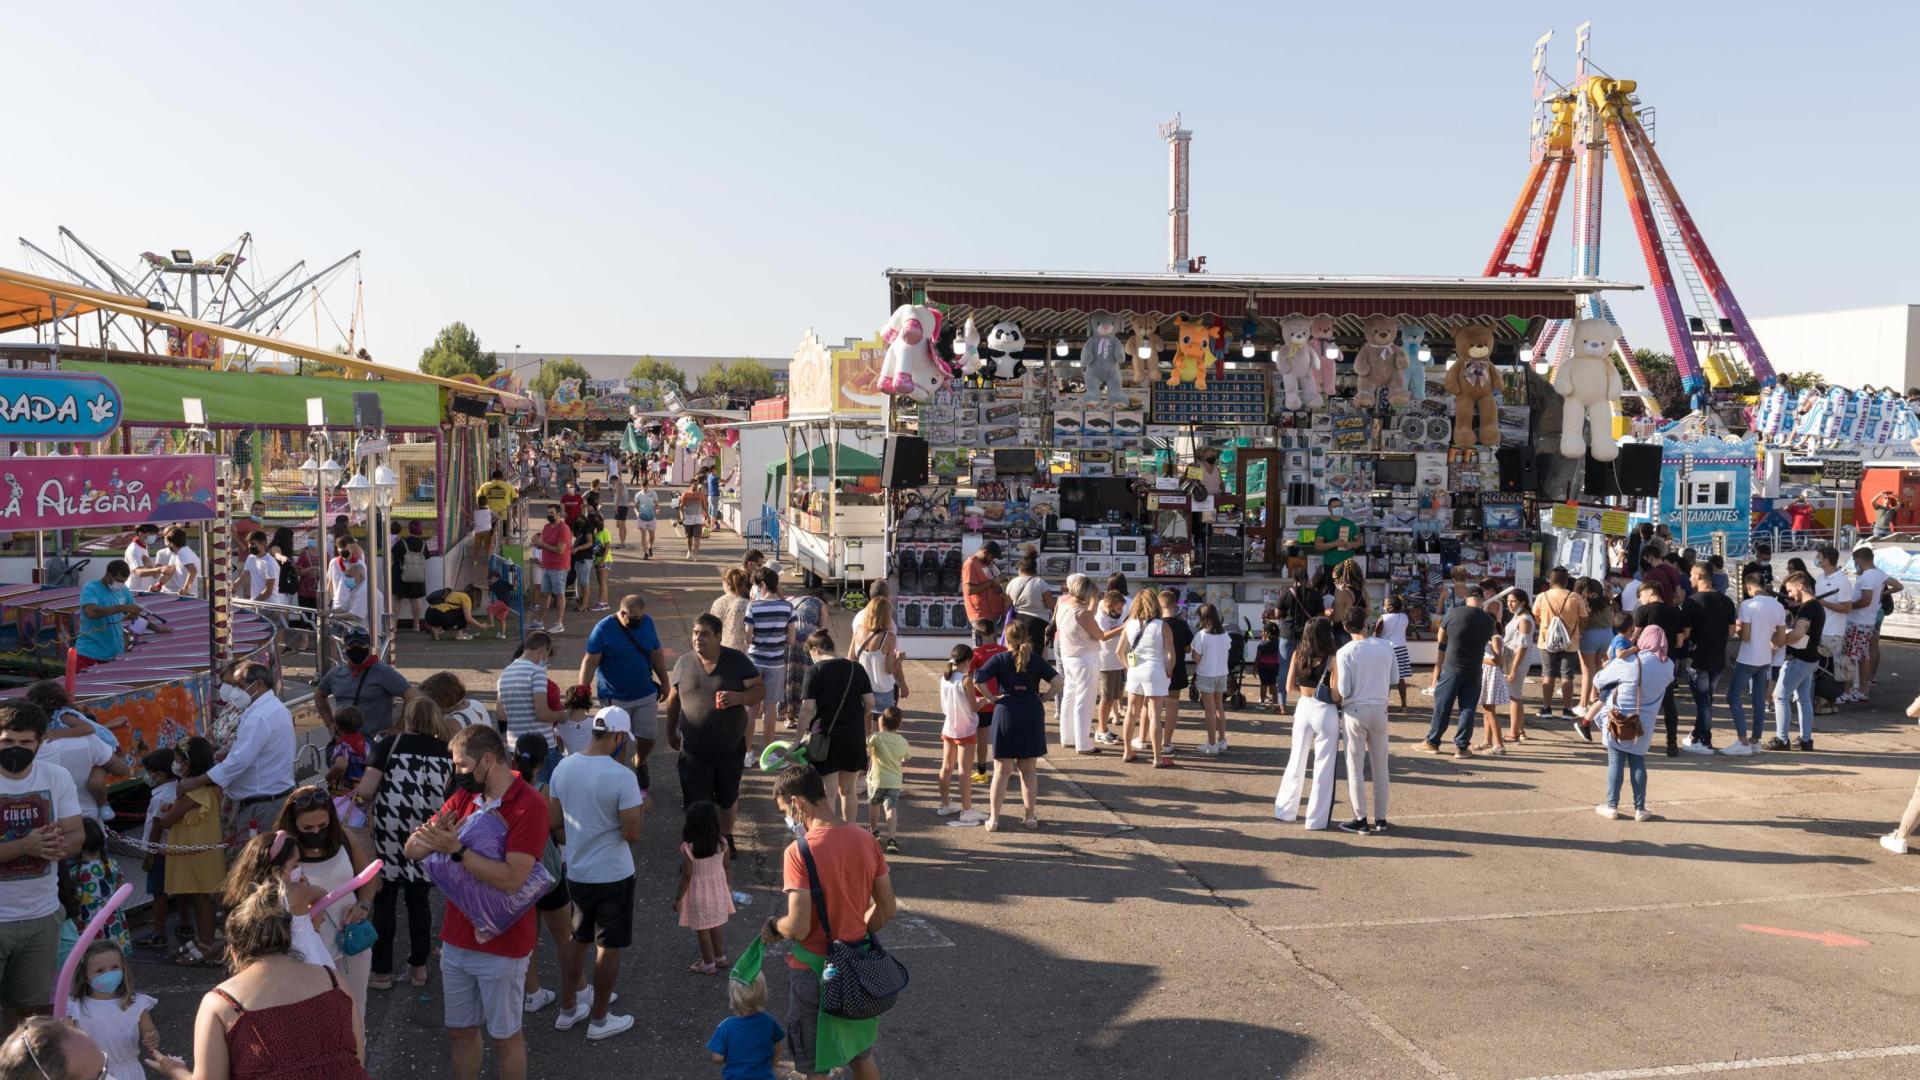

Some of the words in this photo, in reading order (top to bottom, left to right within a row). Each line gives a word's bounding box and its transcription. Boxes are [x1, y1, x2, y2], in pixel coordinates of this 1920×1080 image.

[0, 497, 20, 518] A
[1669, 510, 1740, 522] SATAMONTES
[4, 808, 39, 821] CIRCUS
